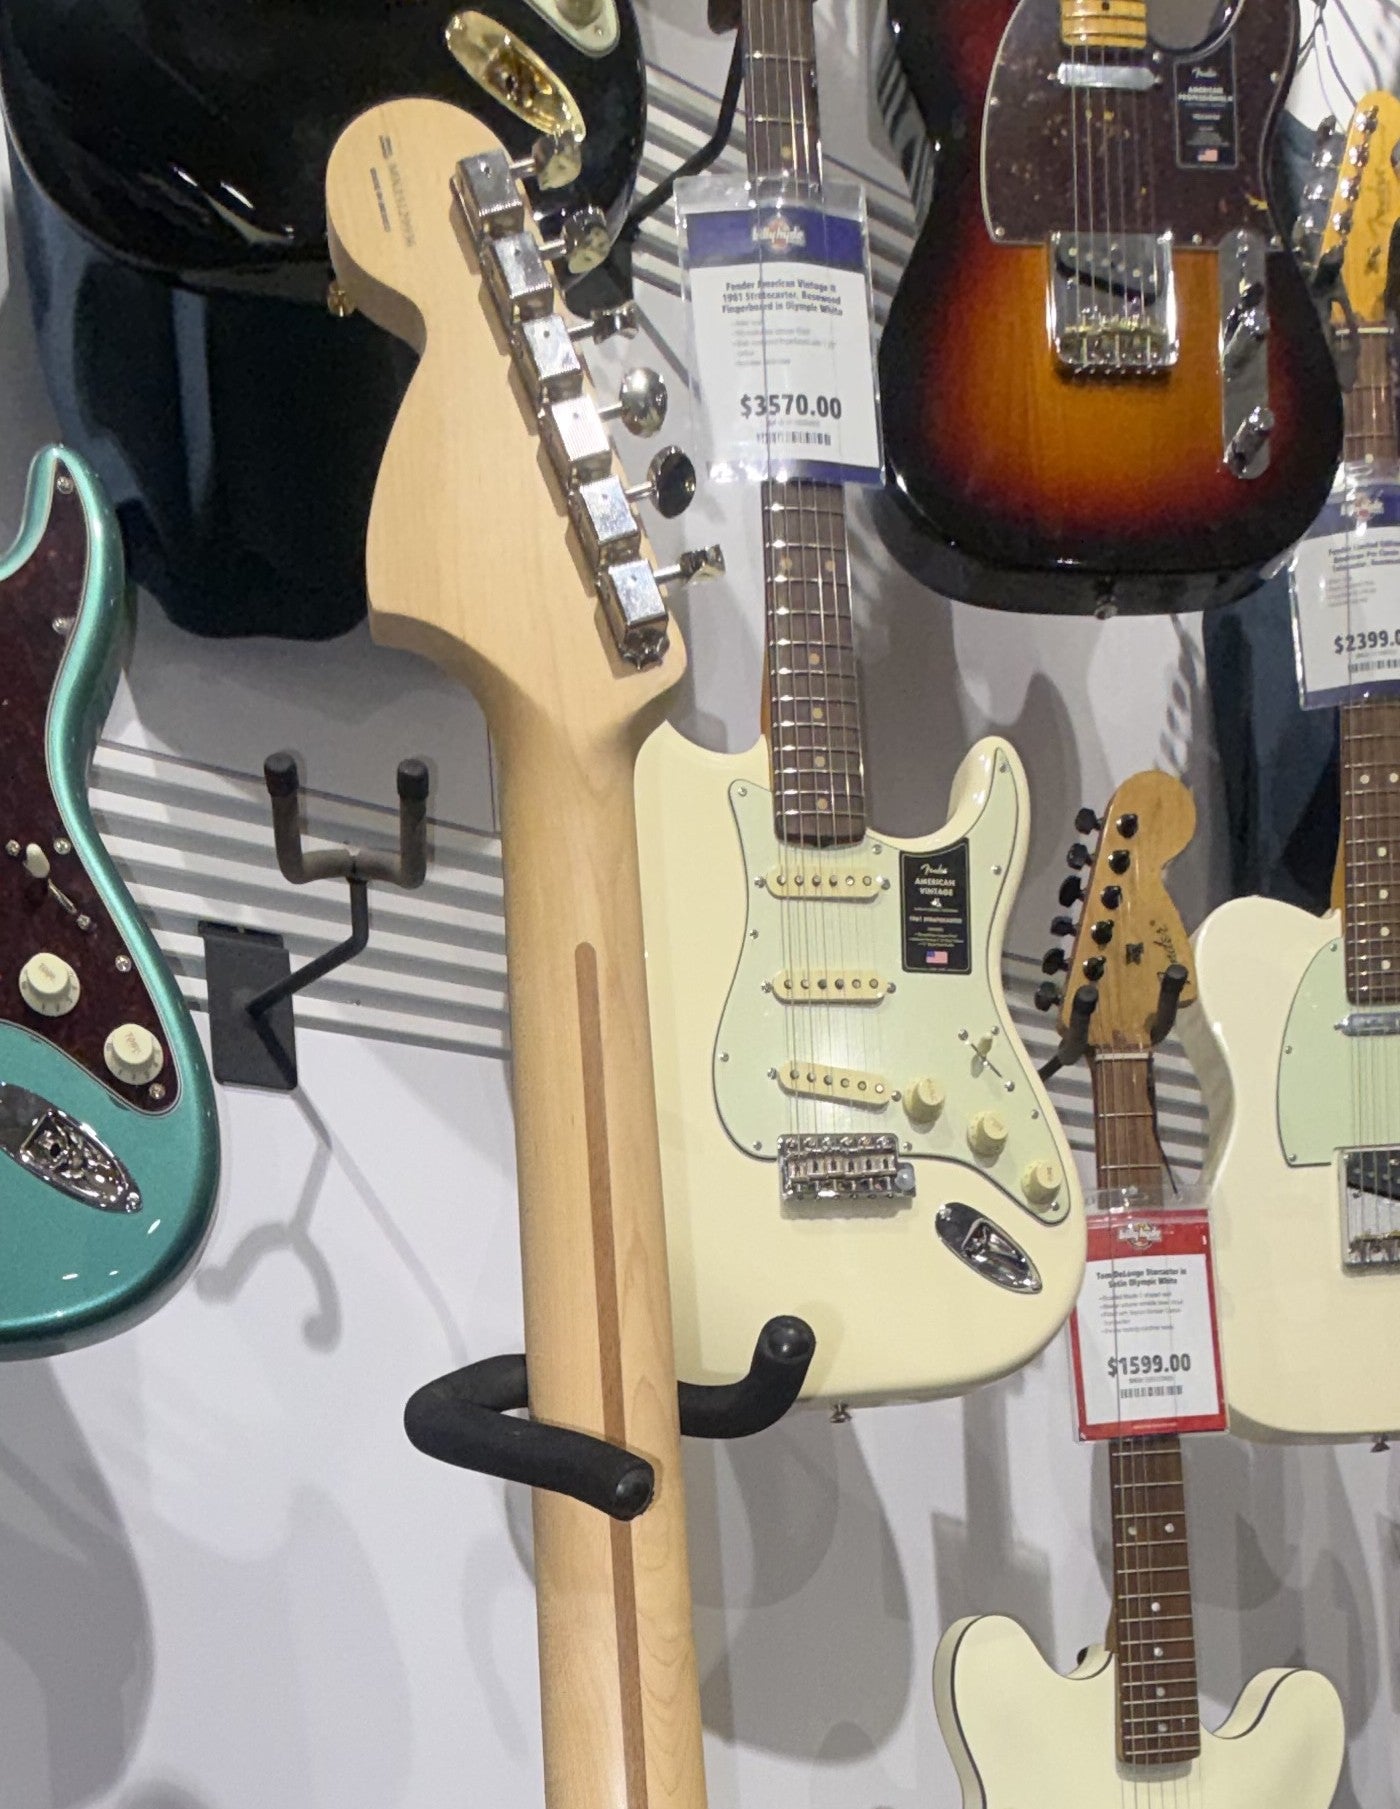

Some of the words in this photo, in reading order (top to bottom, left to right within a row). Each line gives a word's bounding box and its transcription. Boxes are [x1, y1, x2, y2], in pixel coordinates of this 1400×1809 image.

[726, 282, 754, 291] Fender
[740, 393, 842, 420] $3570.00
[914, 878, 956, 887] AMERICAN
[919, 887, 954, 896] VINTAGE
[1107, 1353, 1192, 1378] $1599.00
